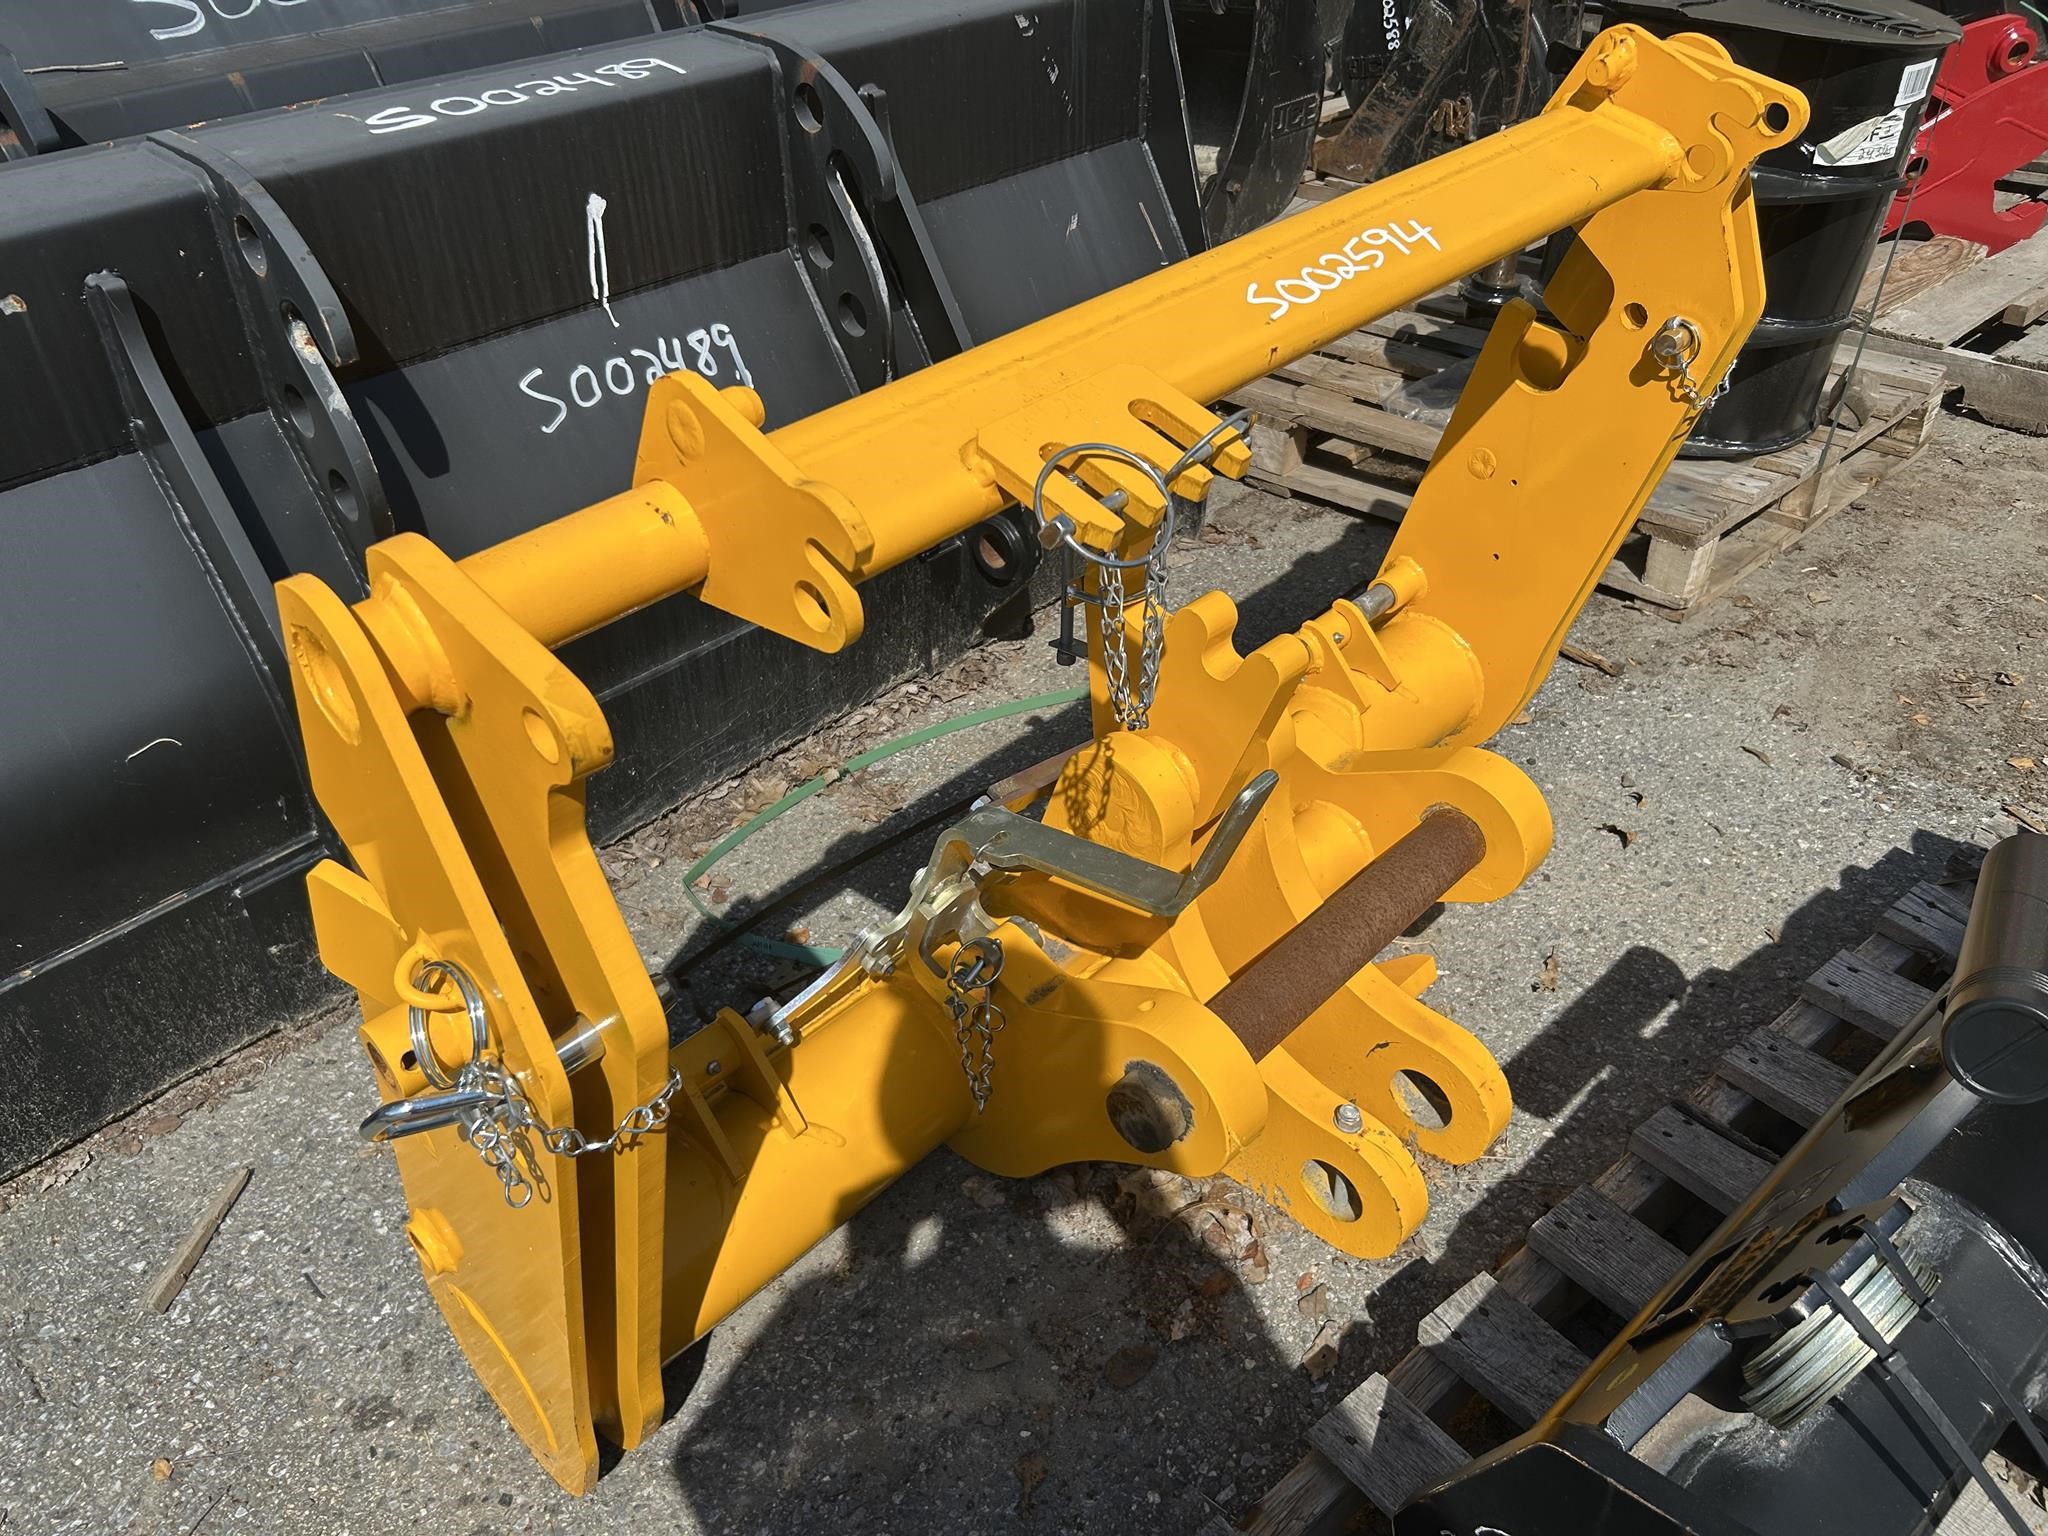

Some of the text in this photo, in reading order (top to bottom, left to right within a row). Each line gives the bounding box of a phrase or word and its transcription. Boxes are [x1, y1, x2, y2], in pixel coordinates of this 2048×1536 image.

[365, 57, 687, 134] S002489
[1247, 219, 1442, 320] S002594
[519, 323, 754, 433] S002489
